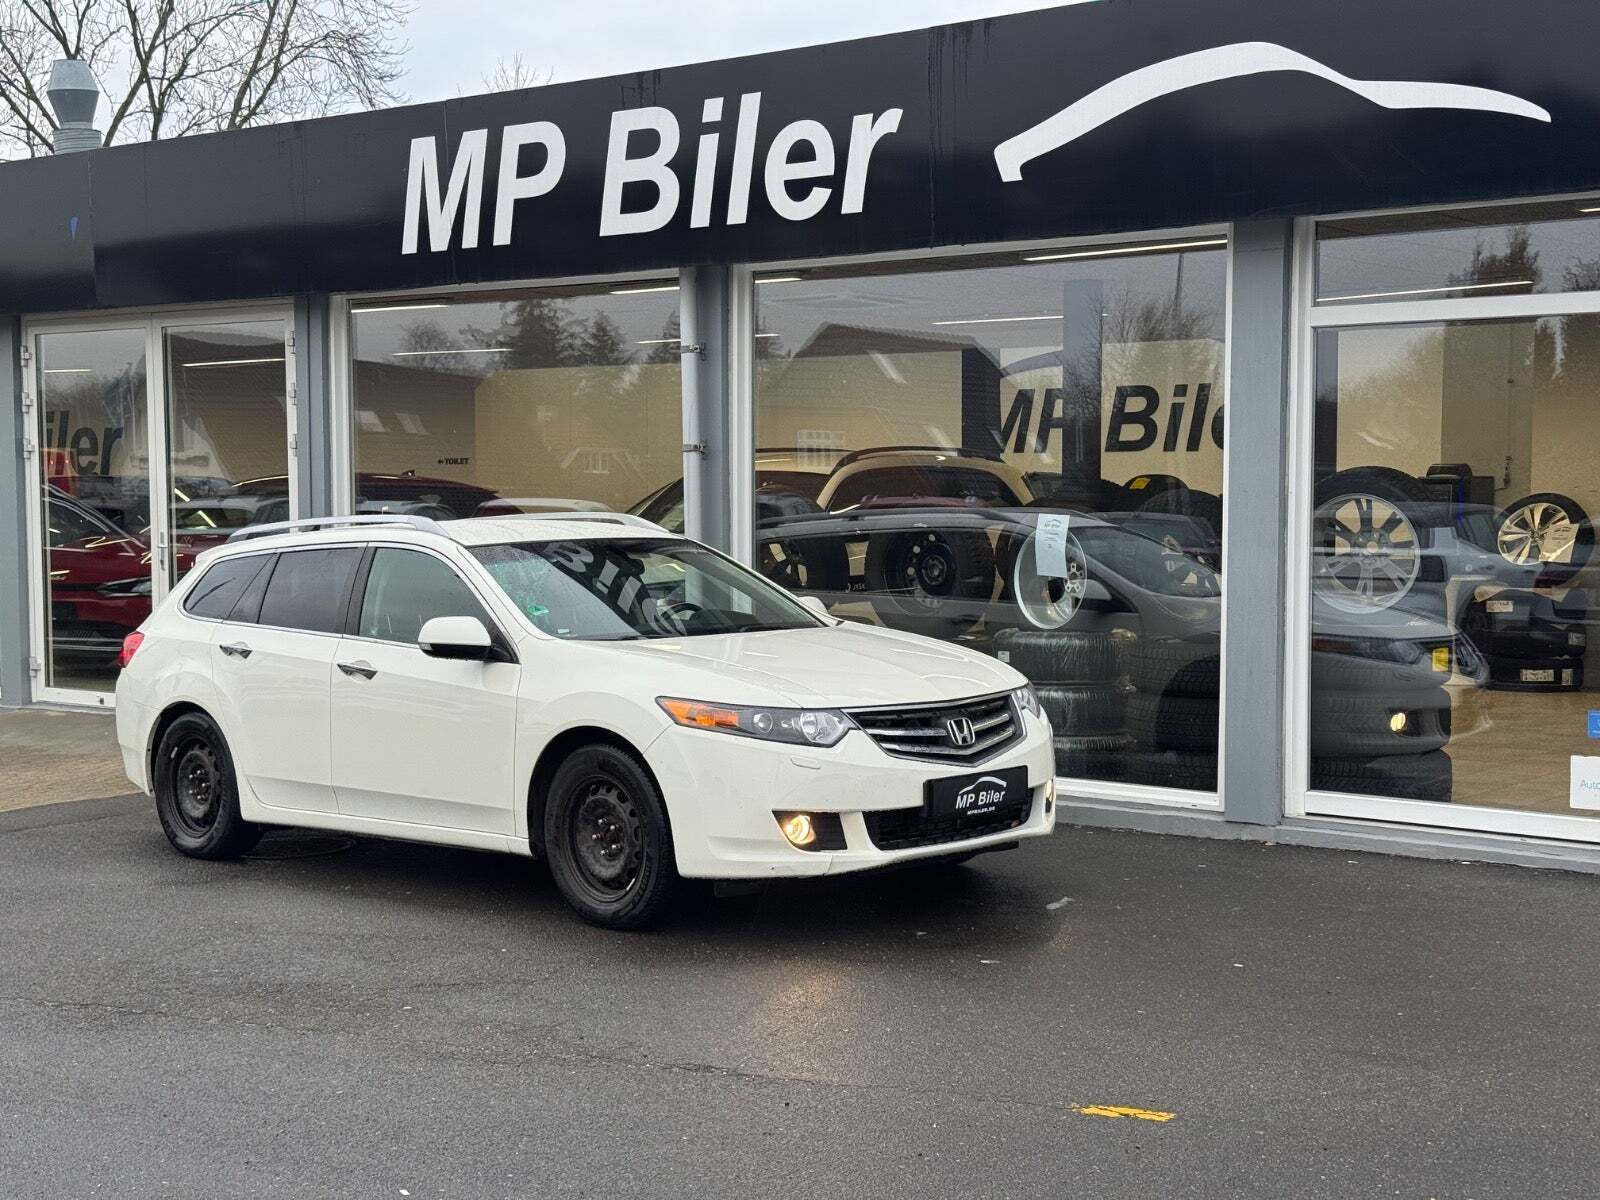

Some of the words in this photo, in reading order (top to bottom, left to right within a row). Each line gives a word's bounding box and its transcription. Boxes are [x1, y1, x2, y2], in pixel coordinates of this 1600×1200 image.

[401, 120, 567, 255] MP
[599, 91, 904, 237] Biler
[1104, 383, 1224, 453] Bil
[445, 457, 469, 465] TOILET
[956, 793, 975, 809] MP
[978, 790, 1005, 805] Biler
